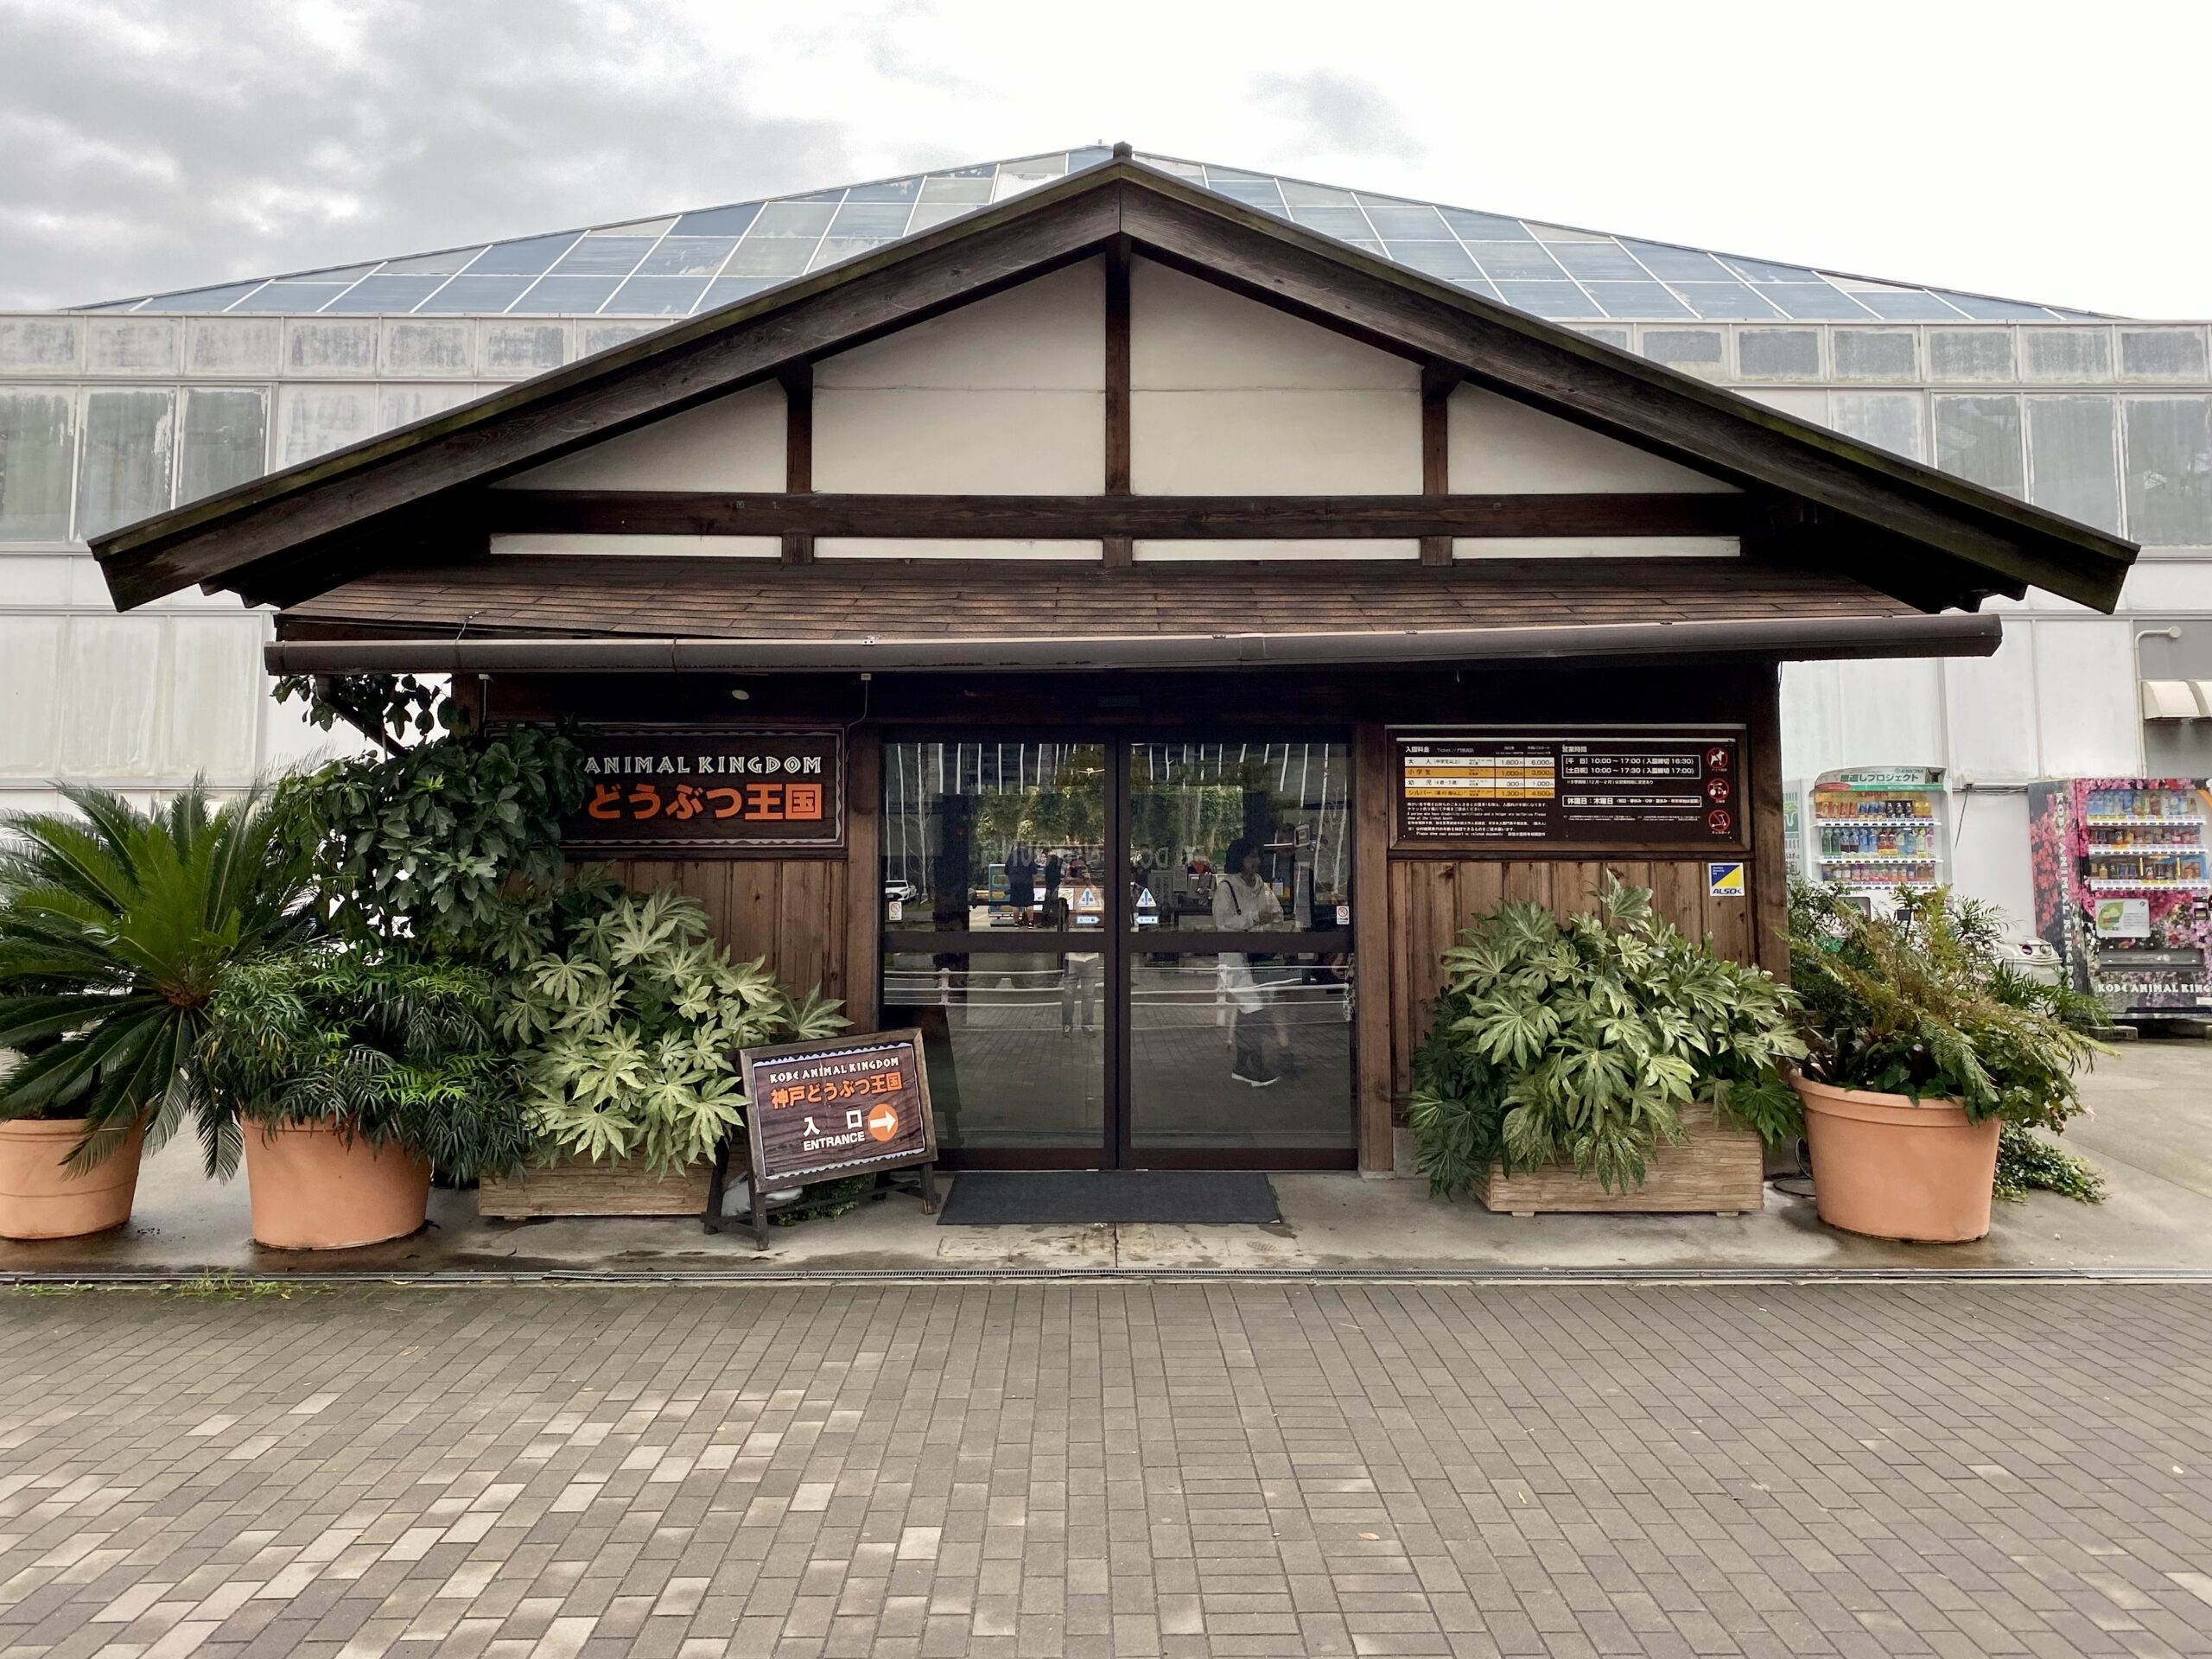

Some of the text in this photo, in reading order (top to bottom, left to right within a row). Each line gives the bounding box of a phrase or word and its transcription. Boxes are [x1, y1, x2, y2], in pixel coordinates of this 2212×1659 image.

[584, 755, 822, 774] ANIMAL KINGDOM
[588, 783, 823, 821] どうぶつ王国
[2063, 918, 2075, 990] KINGDO
[2130, 983, 2179, 993] ANIMAL
[769, 1057, 899, 1084] KOBE ANIMAL KINGDOM
[770, 1071, 903, 1109] 神戸どうぶつ王国
[804, 1131, 866, 1152] ENTRANCE
